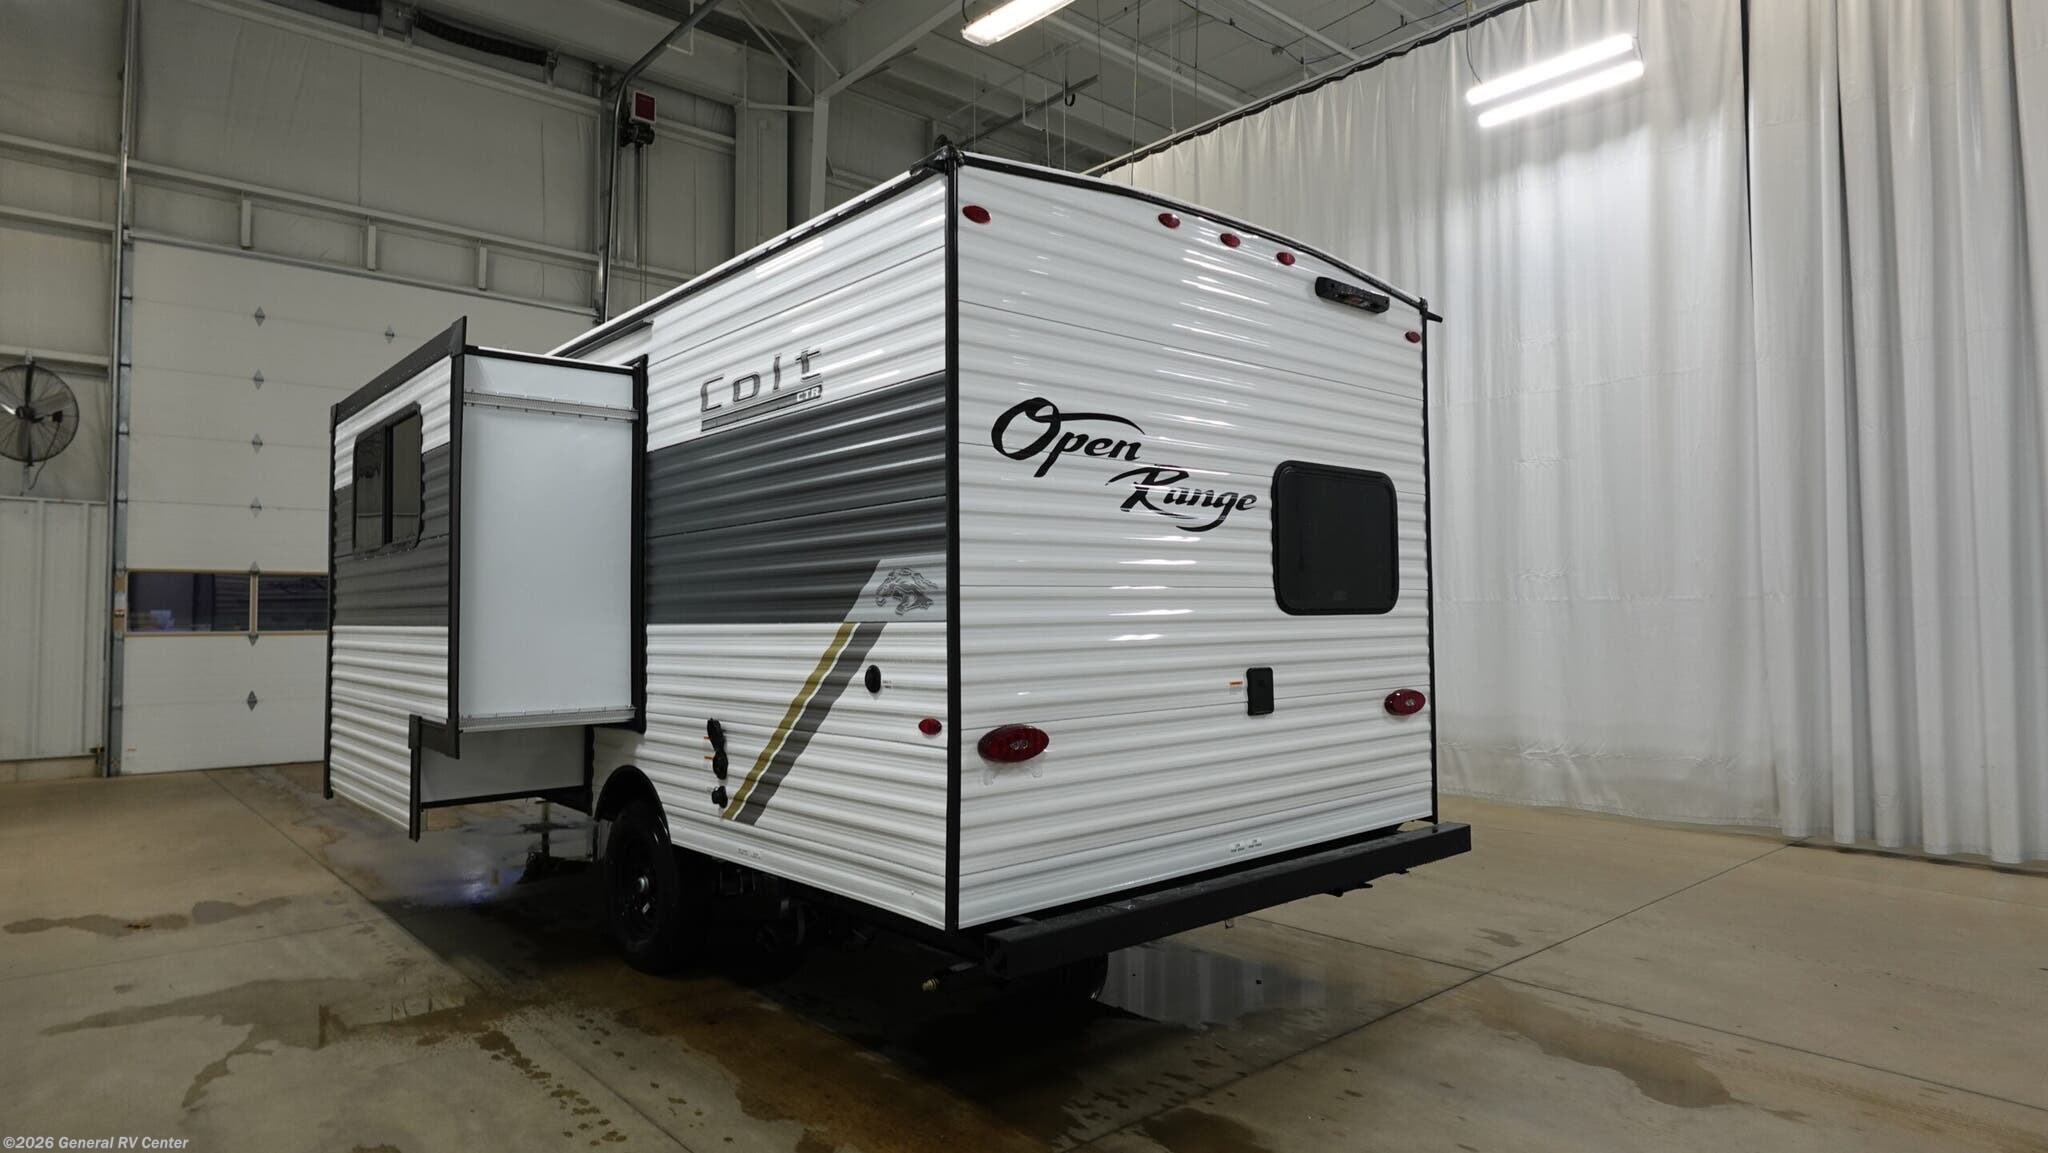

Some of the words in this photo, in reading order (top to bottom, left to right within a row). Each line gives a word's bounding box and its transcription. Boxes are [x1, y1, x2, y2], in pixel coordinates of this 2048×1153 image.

[700, 348, 821, 413] Colt
[796, 387, 821, 401] CTR
[991, 396, 1145, 478] Open
[1105, 463, 1257, 532] Range
